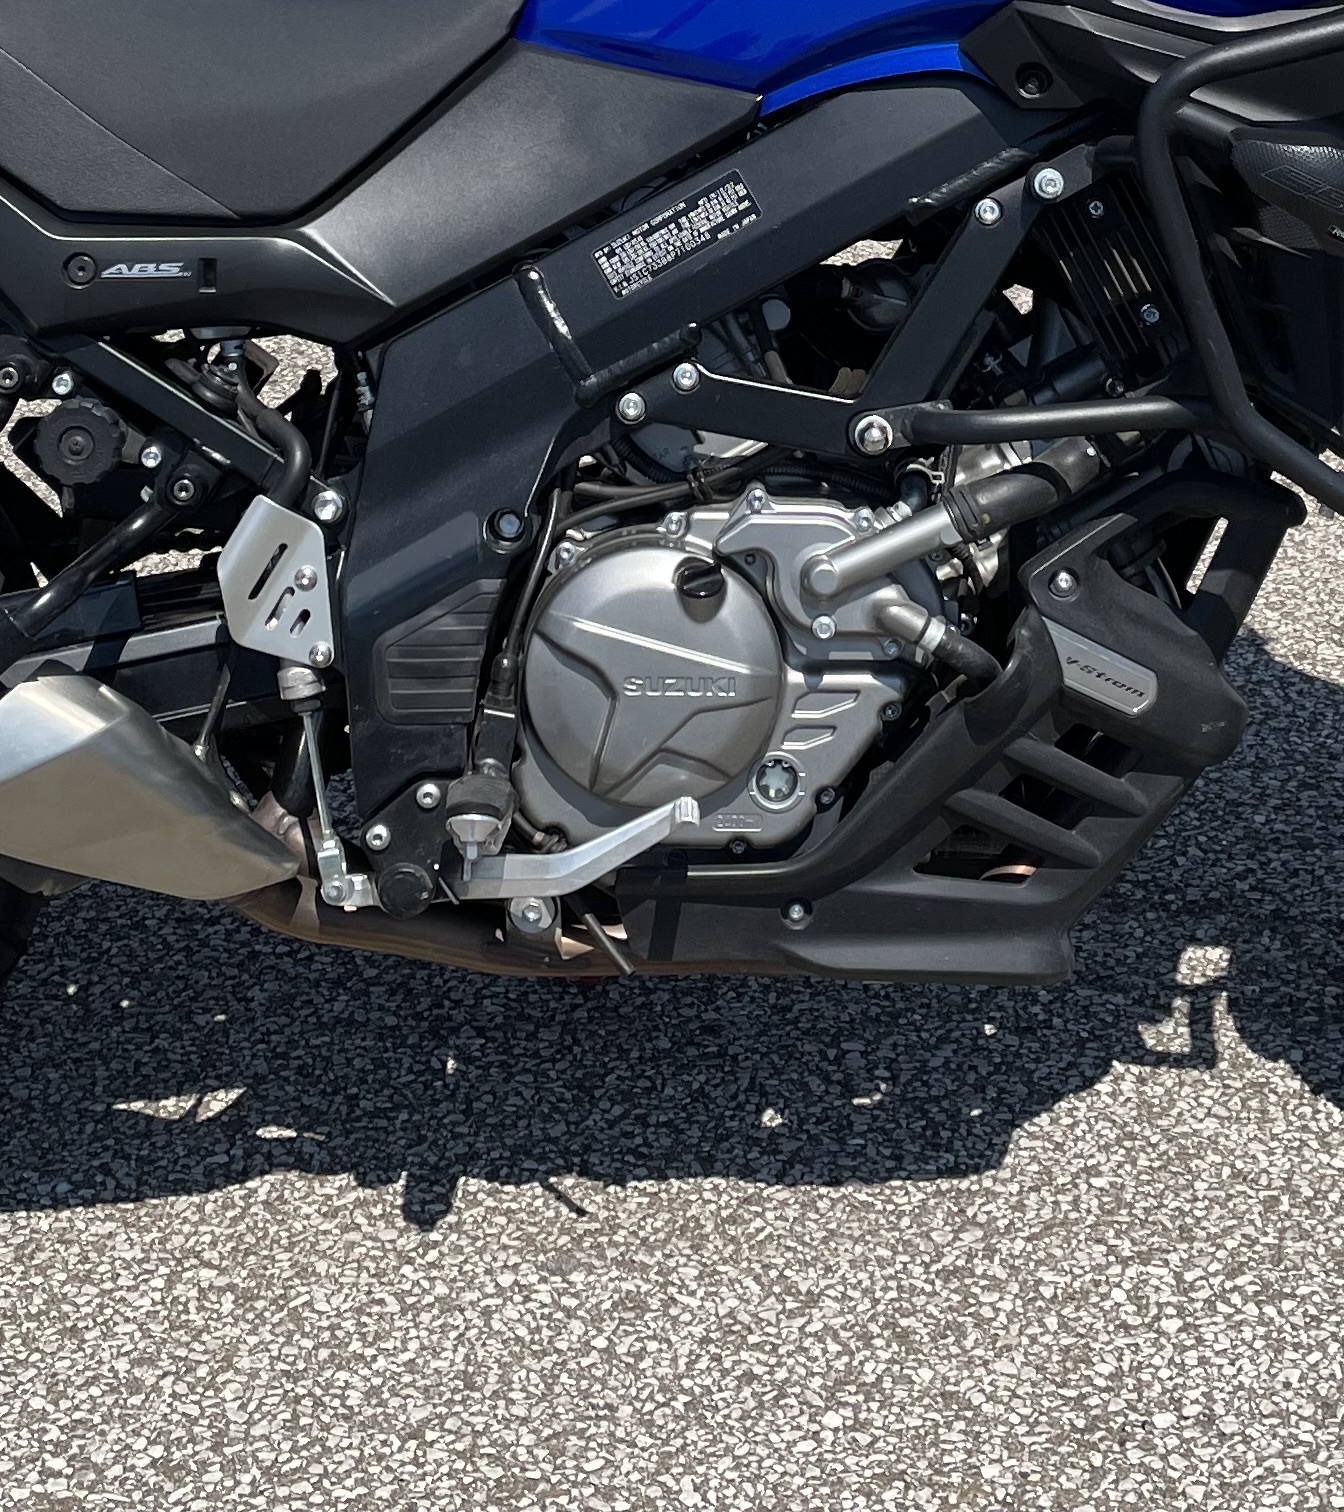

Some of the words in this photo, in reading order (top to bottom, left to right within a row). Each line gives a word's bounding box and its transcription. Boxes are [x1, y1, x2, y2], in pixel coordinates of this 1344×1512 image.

[101, 262, 184, 276] ABS
[623, 676, 736, 697] SUZUKI
[1066, 656, 1146, 698] V-Strom
